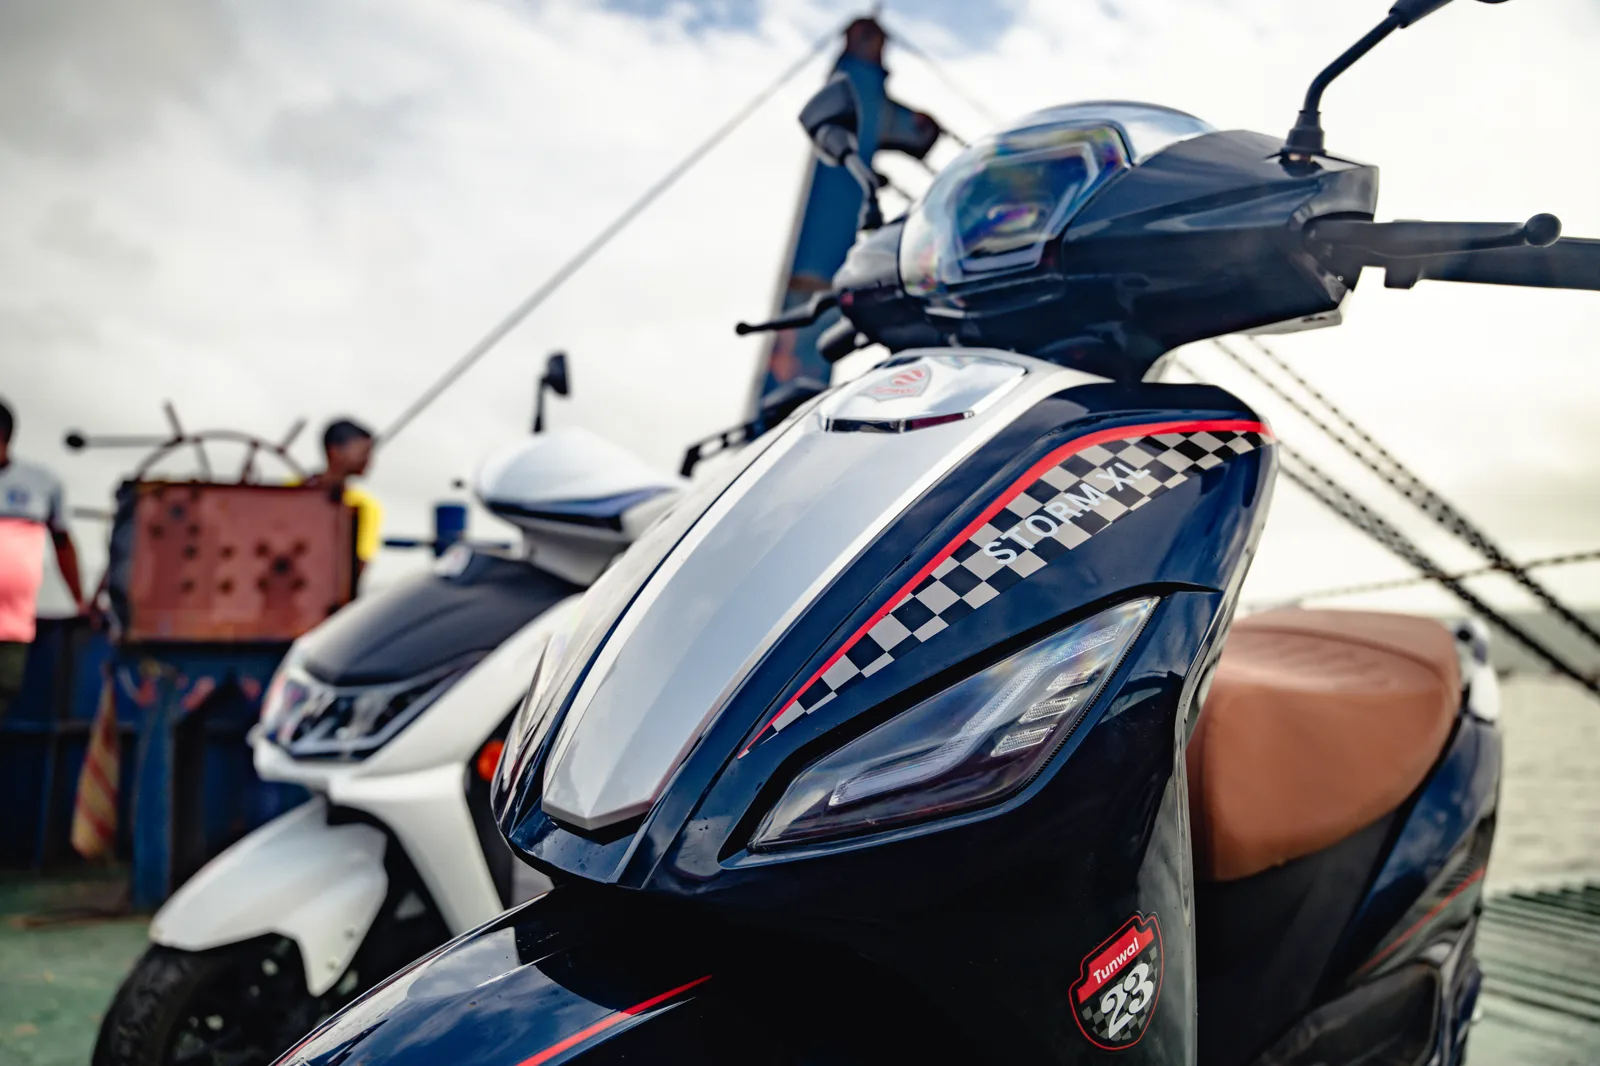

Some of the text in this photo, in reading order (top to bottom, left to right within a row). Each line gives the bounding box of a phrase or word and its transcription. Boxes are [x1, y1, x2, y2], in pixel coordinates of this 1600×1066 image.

[983, 462, 1151, 564] STORM XL
[1093, 937, 1139, 984] Tunwal
[1101, 963, 1154, 1038] 23
